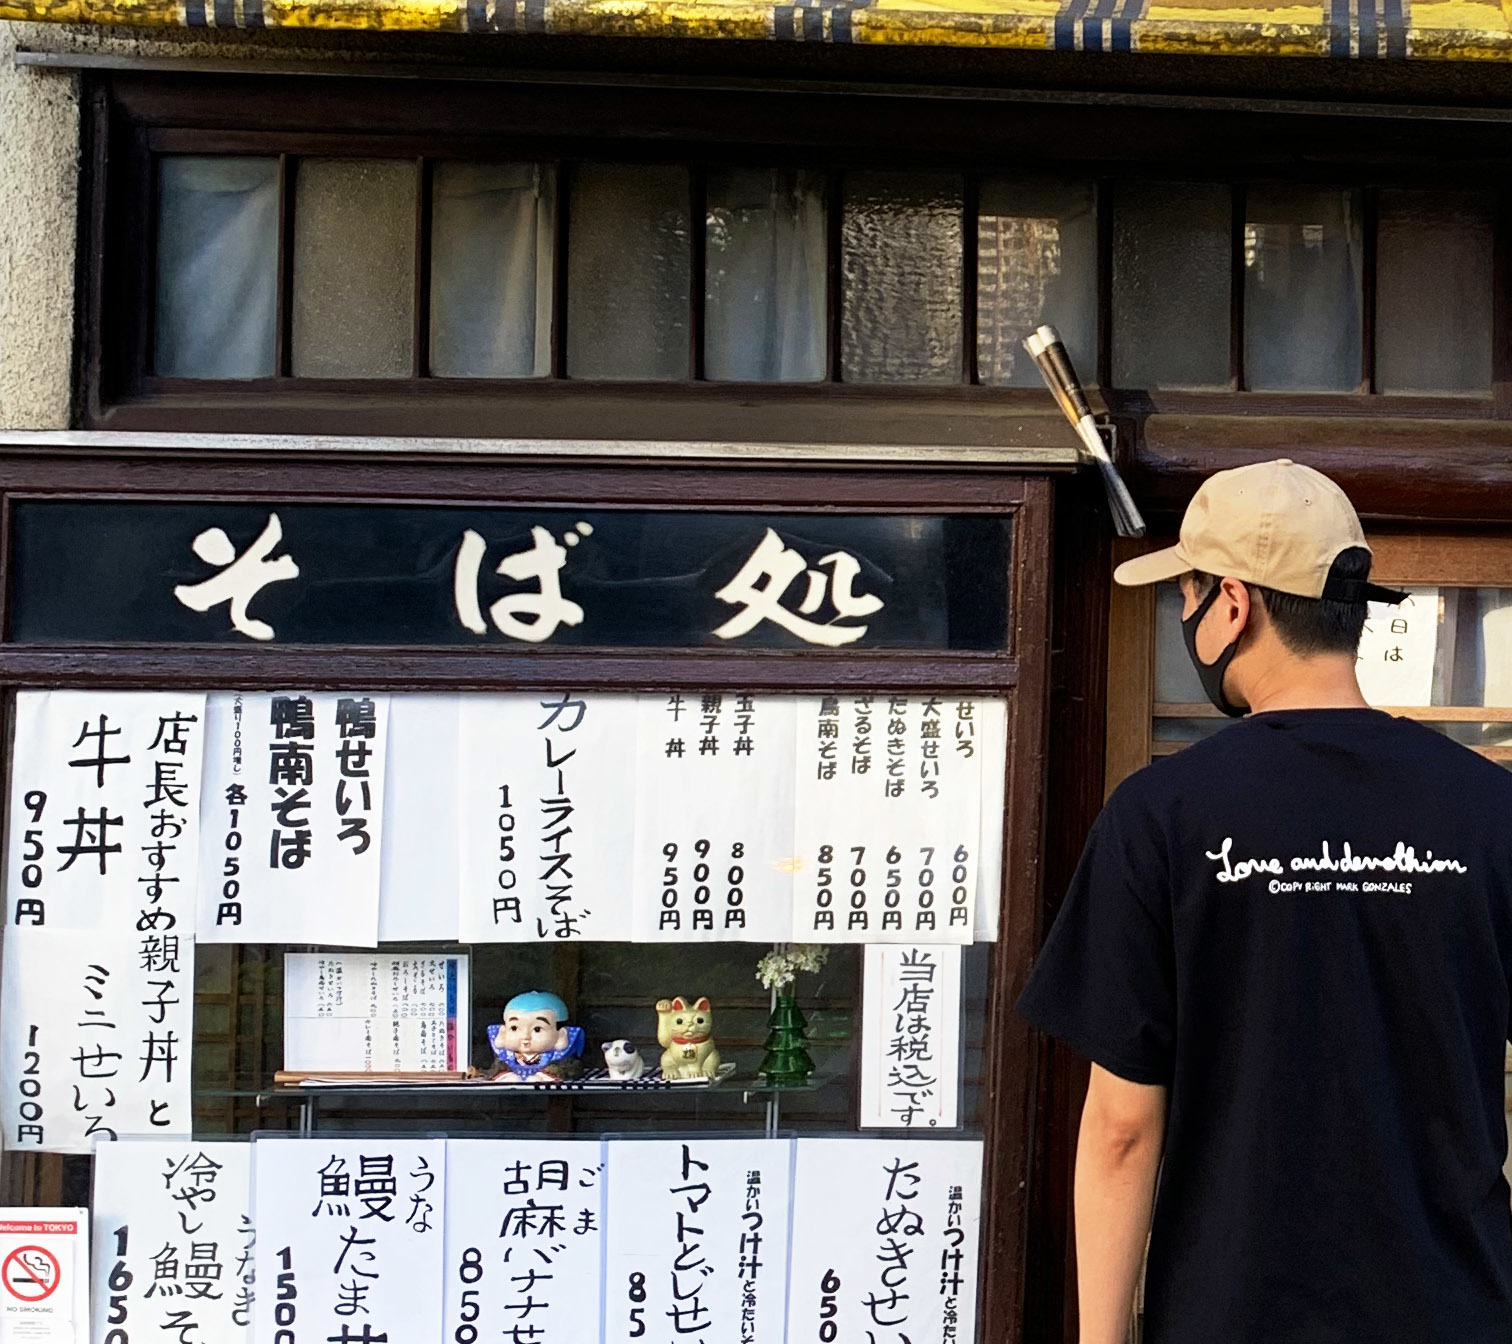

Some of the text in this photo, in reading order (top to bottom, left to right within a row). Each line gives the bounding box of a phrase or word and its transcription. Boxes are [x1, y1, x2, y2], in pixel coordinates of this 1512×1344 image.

[174, 512, 884, 647] そば処
[334, 697, 377, 856] 鴨せいろ
[697, 695, 724, 757] 親子丼
[850, 696, 876, 775] ざるそば
[884, 697, 909, 799] たぬきそば
[919, 697, 943, 799] 大盛せいろ
[953, 700, 976, 759] せいろ
[56, 713, 131, 876] 牛丼
[135, 710, 199, 932] 店長おすすめ
[269, 694, 315, 870] 鴨南そば
[534, 693, 593, 940] カレーライスそば
[14, 790, 48, 926] 950円
[215, 783, 248, 926] 各1050円
[492, 784, 522, 925] 1050円
[658, 842, 681, 931] 950円
[692, 839, 714, 931] 900円
[724, 842, 746, 929] 800円
[813, 844, 835, 931] 850円
[847, 846, 869, 931] 700円
[881, 845, 902, 931] 650円
[915, 847, 936, 931] 700円
[948, 844, 969, 927] 600円
[68, 962, 125, 1142] ミニせいろ
[138, 934, 181, 1127] 親子丼と
[885, 947, 938, 1127] 当店は税込です。
[17, 1024, 44, 1145] 1200円
[43, 1223, 74, 1232] TOKYO
[405, 1155, 435, 1234] うな
[572, 1161, 606, 1236] ごま
